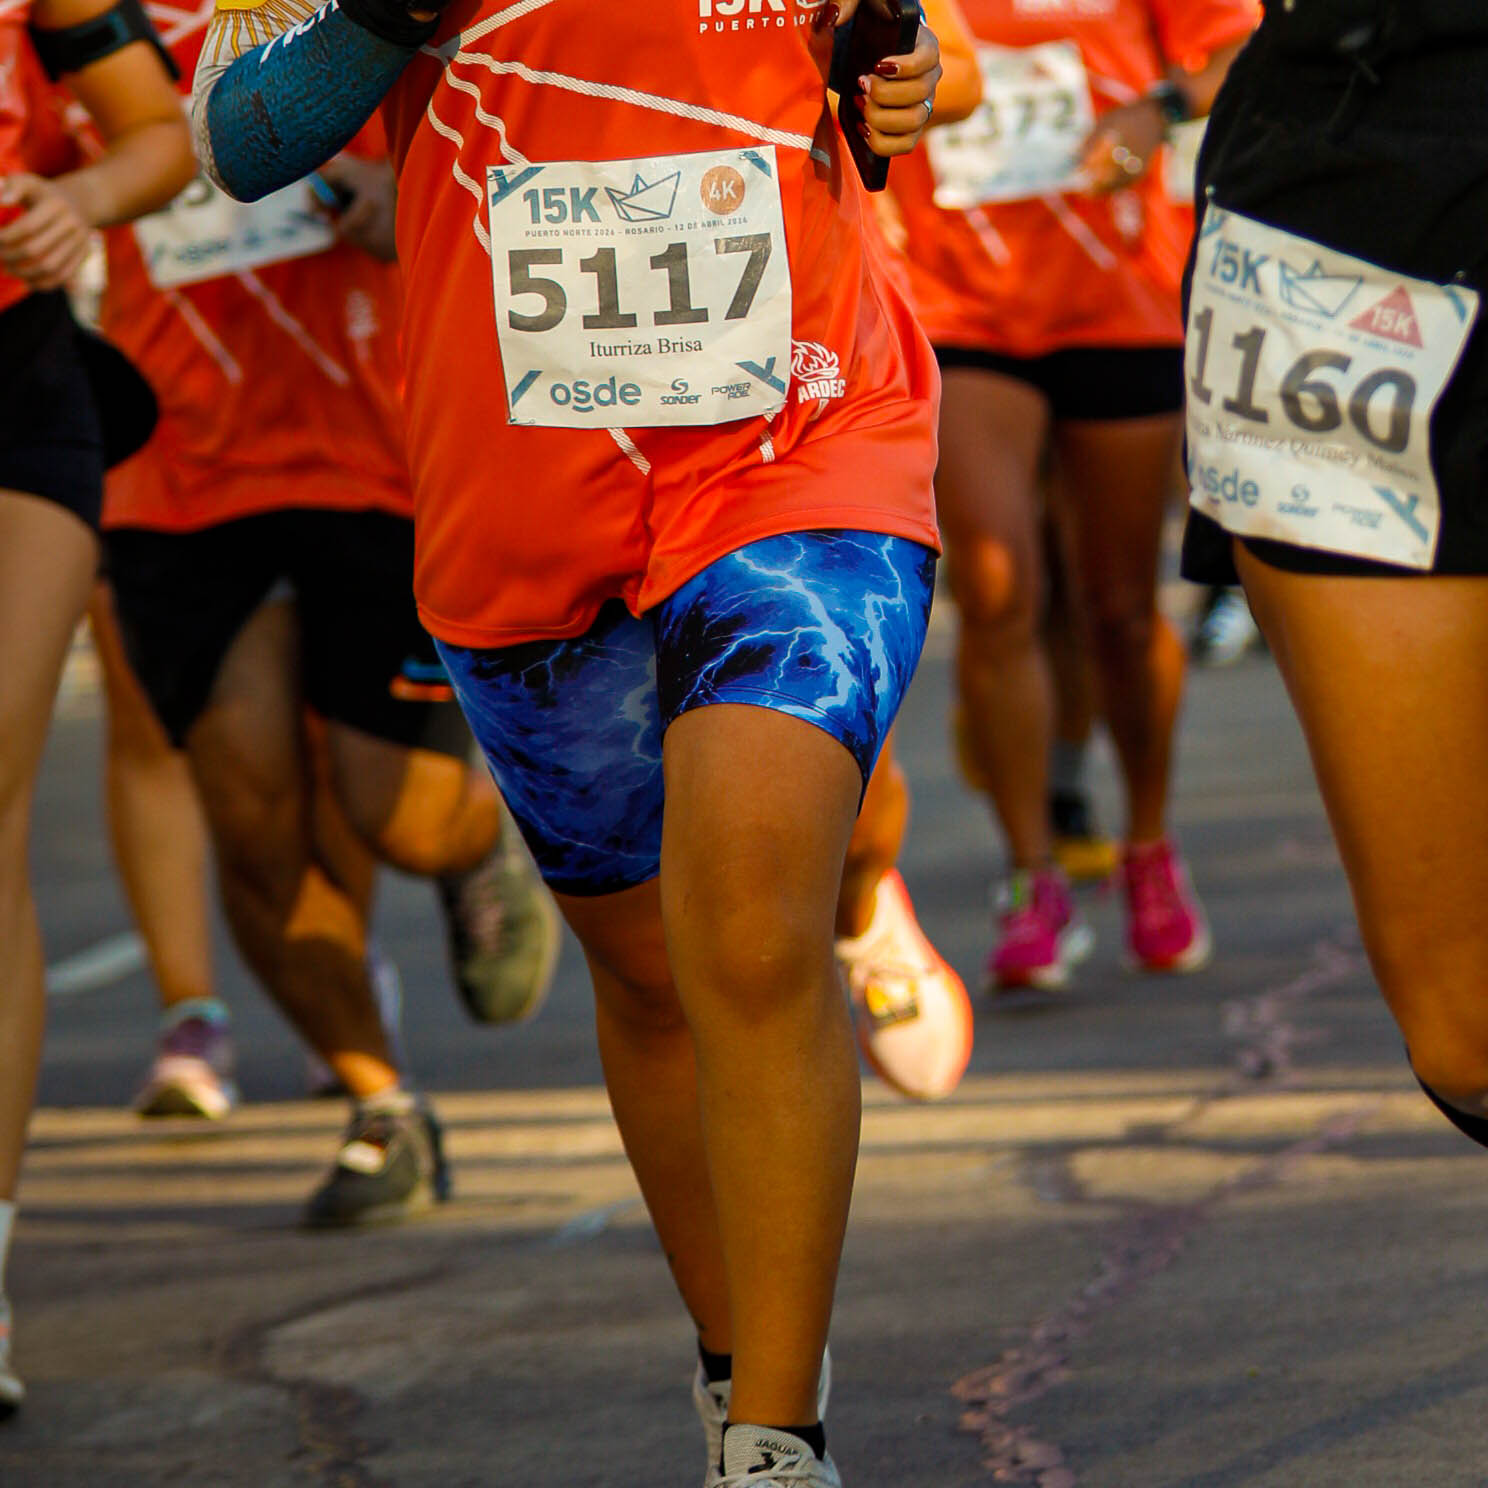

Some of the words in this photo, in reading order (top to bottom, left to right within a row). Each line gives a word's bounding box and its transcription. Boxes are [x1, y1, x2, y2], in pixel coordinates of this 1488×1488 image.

[699, 16, 785, 34] PUERTO
[709, 179, 737, 202] 4K
[523, 187, 602, 225] 15K
[525, 229, 560, 238] PUERTO
[563, 228, 591, 237] NORTE
[624, 225, 665, 235] ROSARIO
[675, 223, 684, 232] 12
[687, 221, 698, 230] DE
[701, 218, 725, 229] ABRIL
[1210, 238, 1271, 296] 15K
[507, 232, 772, 332] 5117
[1370, 304, 1414, 338] 15K
[590, 339, 653, 357] Iturriza
[656, 336, 704, 354] Brisa
[550, 376, 642, 409] osde
[711, 382, 751, 395] POWER
[797, 379, 847, 403] ARDEC
[1190, 306, 1417, 454] 1160
